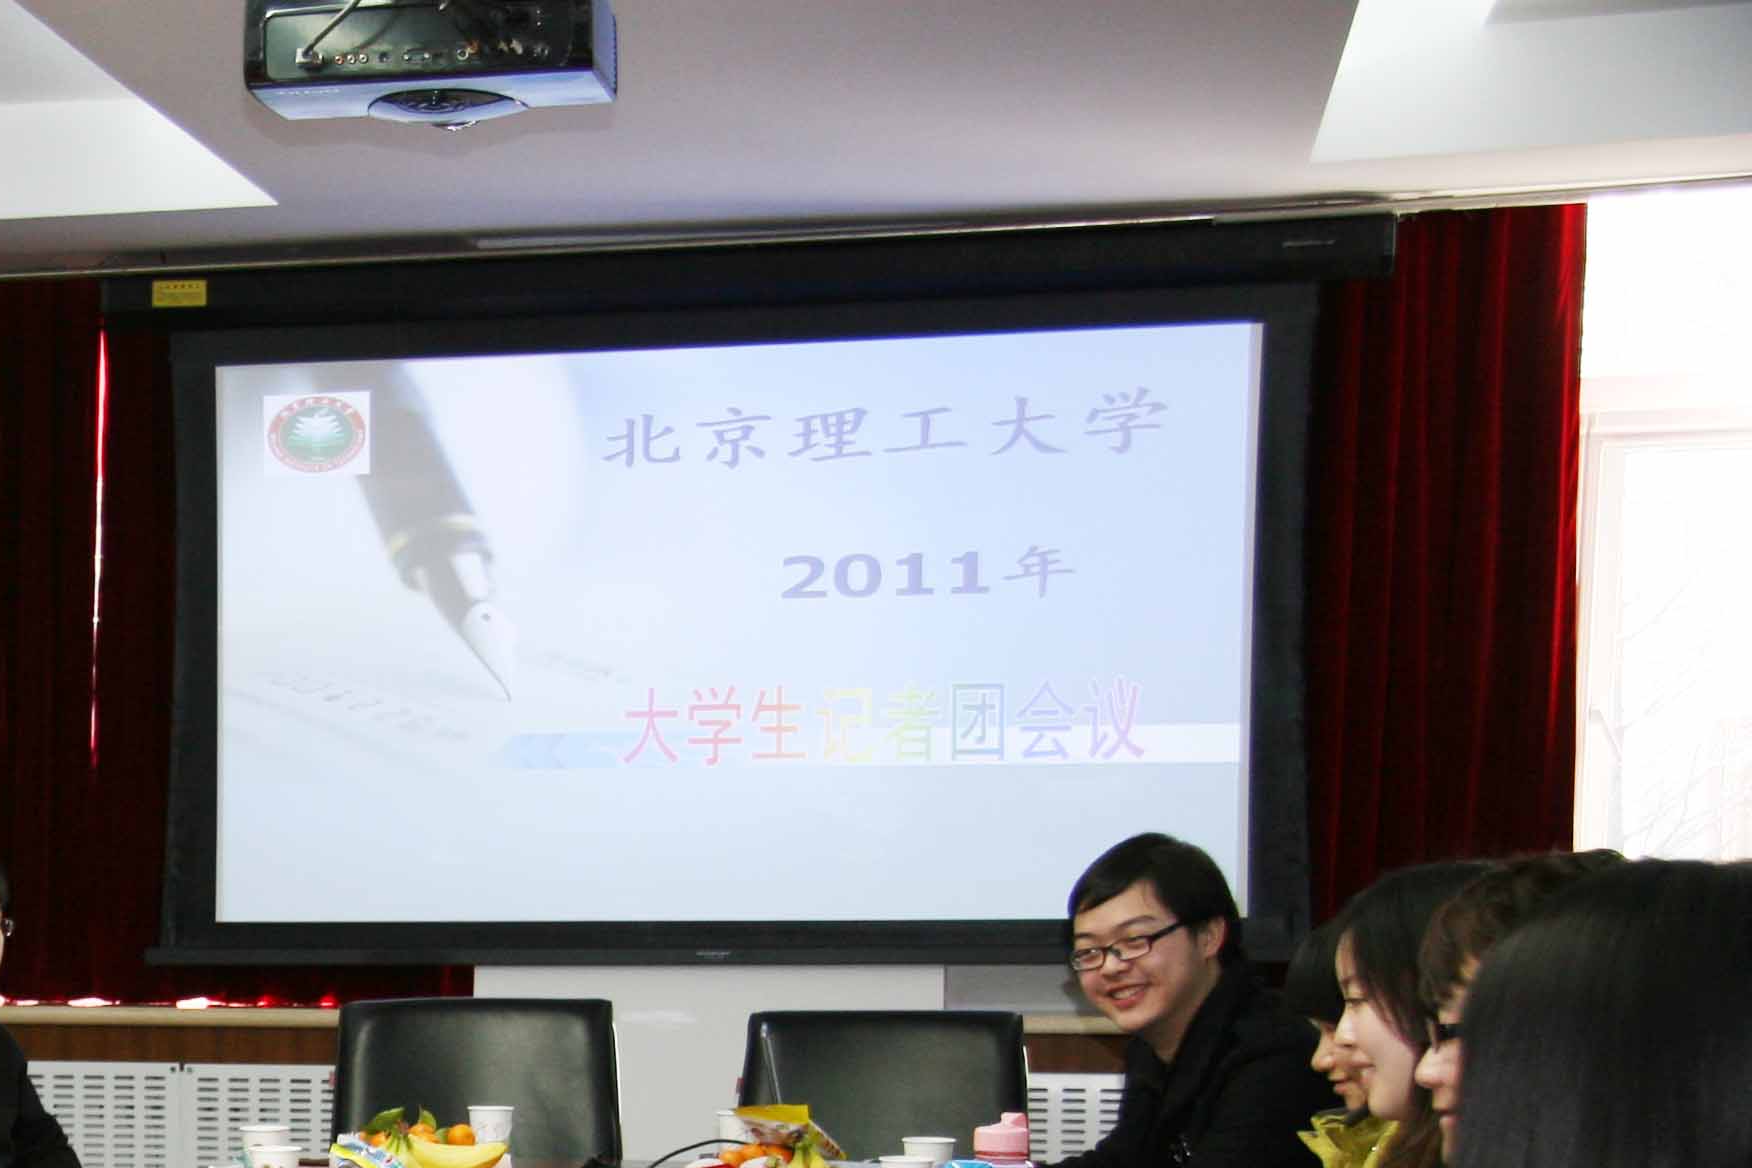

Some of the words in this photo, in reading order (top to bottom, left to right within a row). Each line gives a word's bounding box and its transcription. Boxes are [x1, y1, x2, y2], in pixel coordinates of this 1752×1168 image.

[602, 388, 1169, 469] 北京理工大学
[781, 546, 1076, 600] 2011年
[623, 675, 1145, 767] 大学生记者团会议
